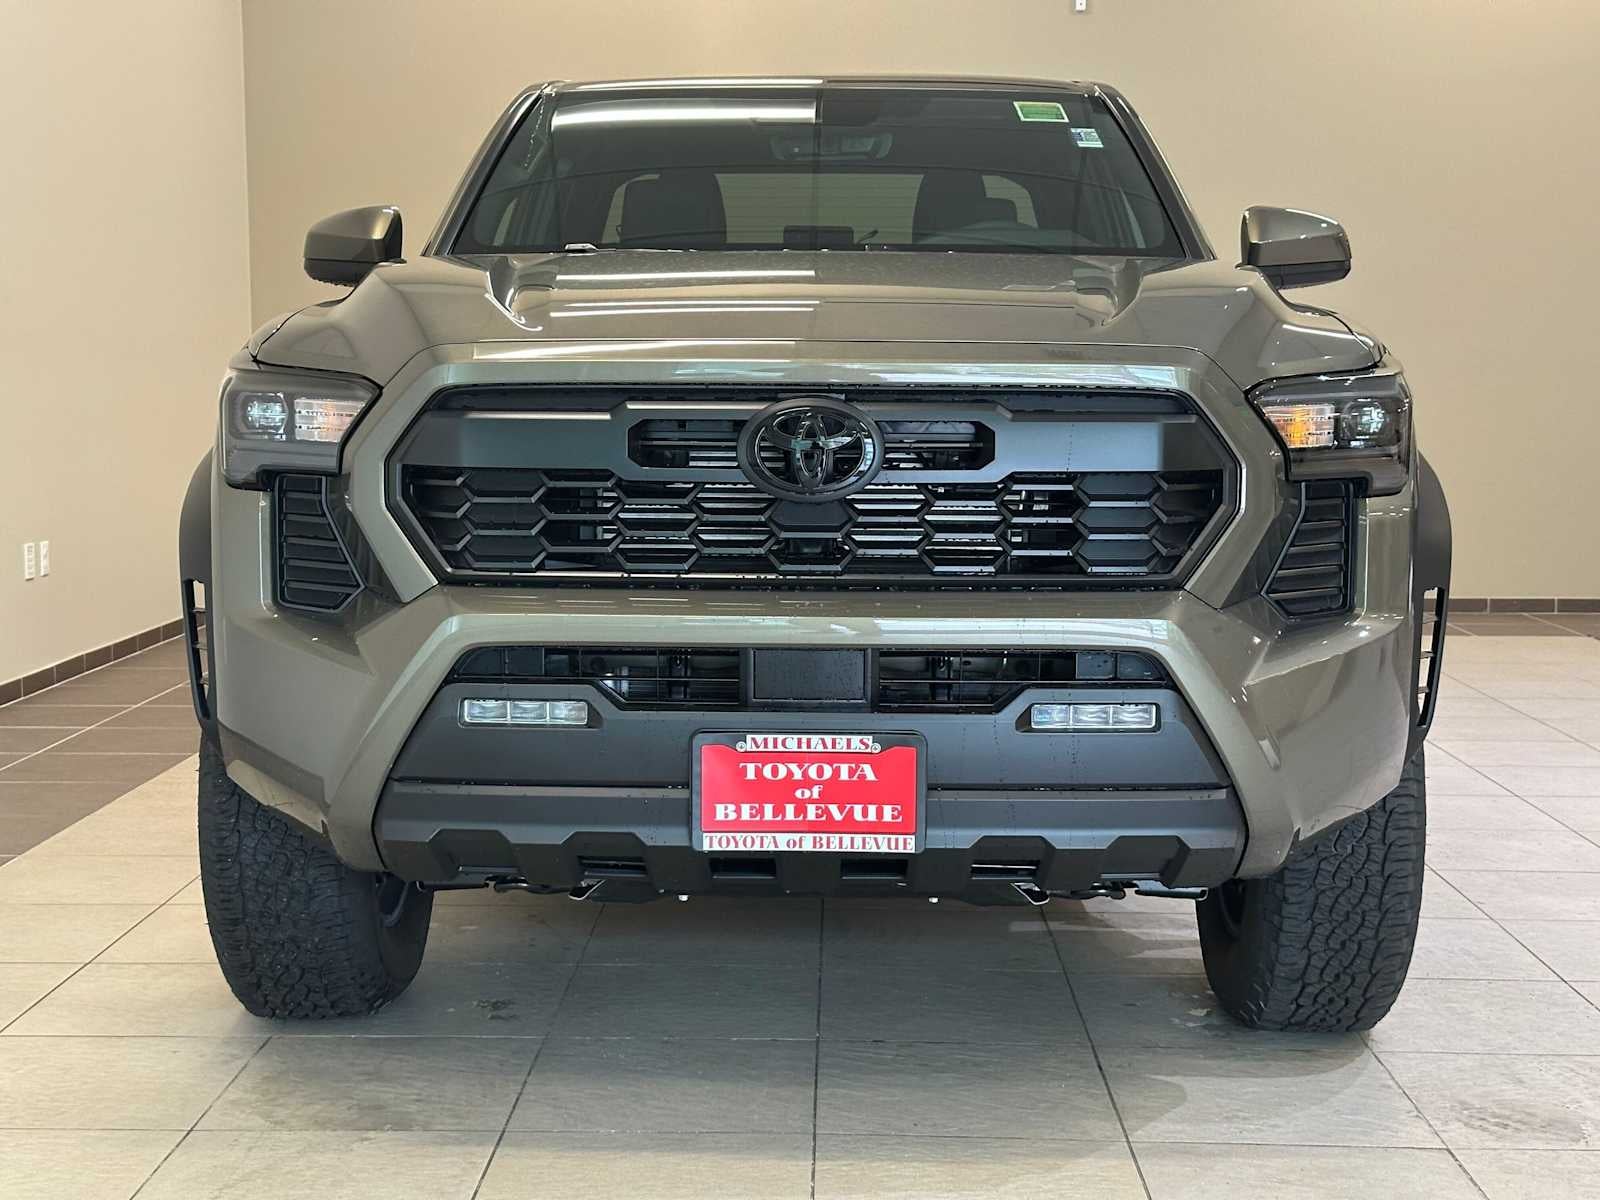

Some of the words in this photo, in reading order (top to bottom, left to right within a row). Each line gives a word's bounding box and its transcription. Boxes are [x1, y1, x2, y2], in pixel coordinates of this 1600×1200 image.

[750, 737, 870, 751] MICHAELS
[739, 762, 878, 781] TOYOTA
[794, 785, 824, 800] of
[713, 803, 903, 823] BELLEVUE
[704, 835, 780, 850] TOYOTA
[786, 835, 807, 850] of
[812, 836, 914, 851] BELLEVUE
